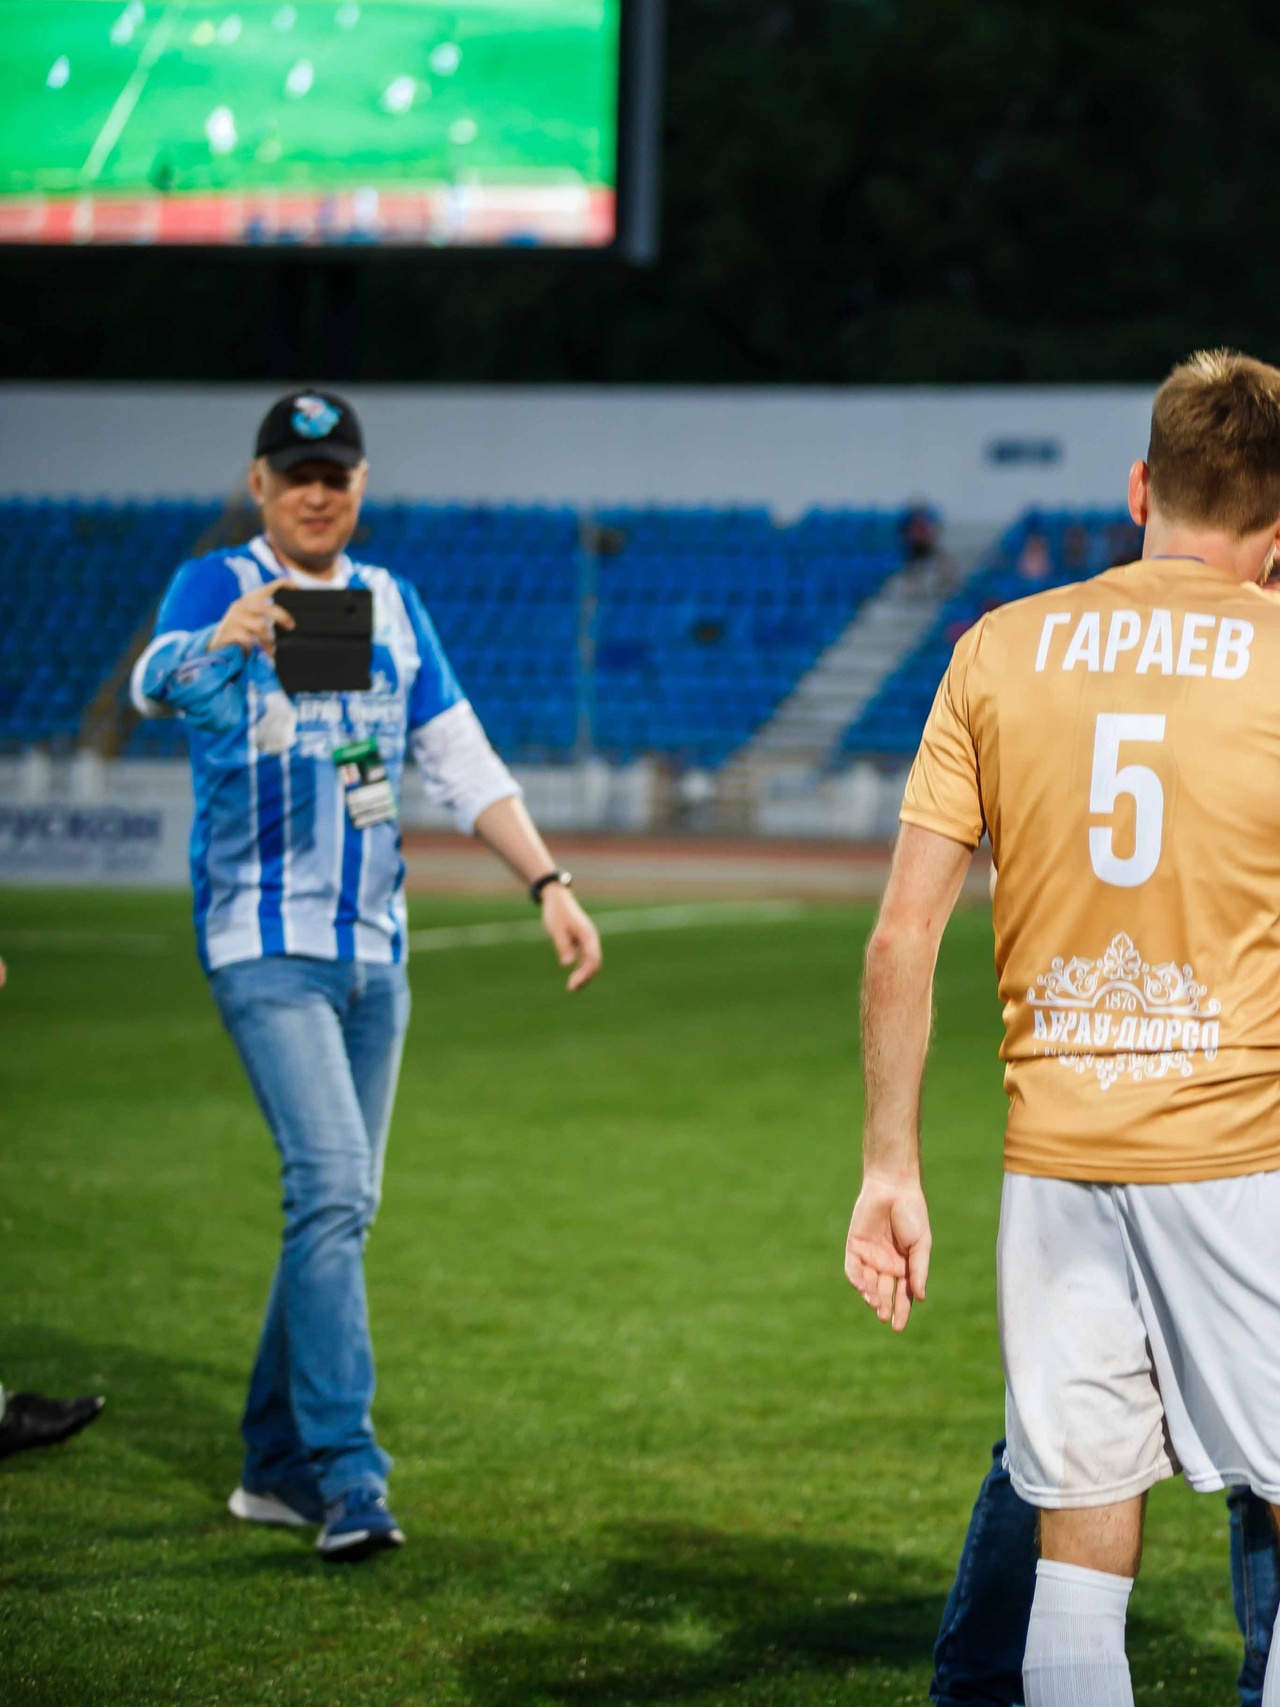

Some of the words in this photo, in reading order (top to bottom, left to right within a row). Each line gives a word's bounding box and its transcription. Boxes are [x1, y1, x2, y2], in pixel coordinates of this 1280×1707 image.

[1035, 608, 1255, 681] ГАРАЕВ
[1089, 712, 1166, 888] 5
[1104, 990, 1138, 1012] 1870
